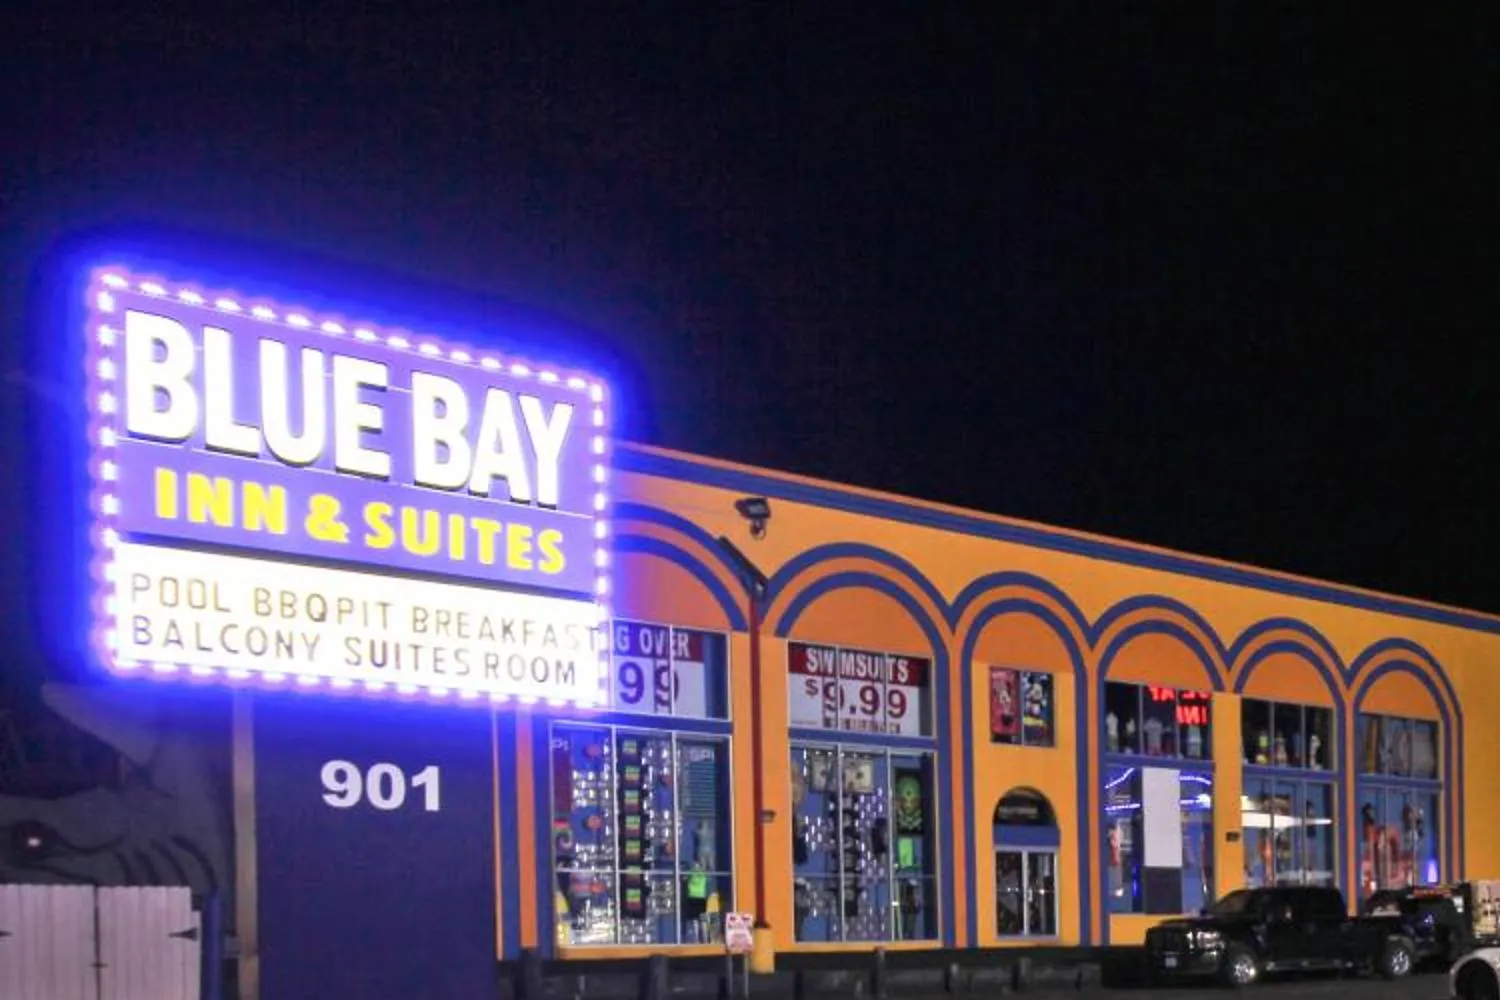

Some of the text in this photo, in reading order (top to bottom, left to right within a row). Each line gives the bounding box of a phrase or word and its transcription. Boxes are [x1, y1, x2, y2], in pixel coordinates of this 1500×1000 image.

[125, 309, 575, 509] BLUE BAY
[155, 467, 567, 574] INN & SUITES
[131, 573, 231, 613] POOL
[411, 605, 600, 651] BREAKFAST
[639, 628, 690, 659] OVER
[132, 614, 576, 687] BALCONY SUITES ROOM
[805, 647, 910, 683] SWMSUITS
[320, 759, 440, 812] 901
